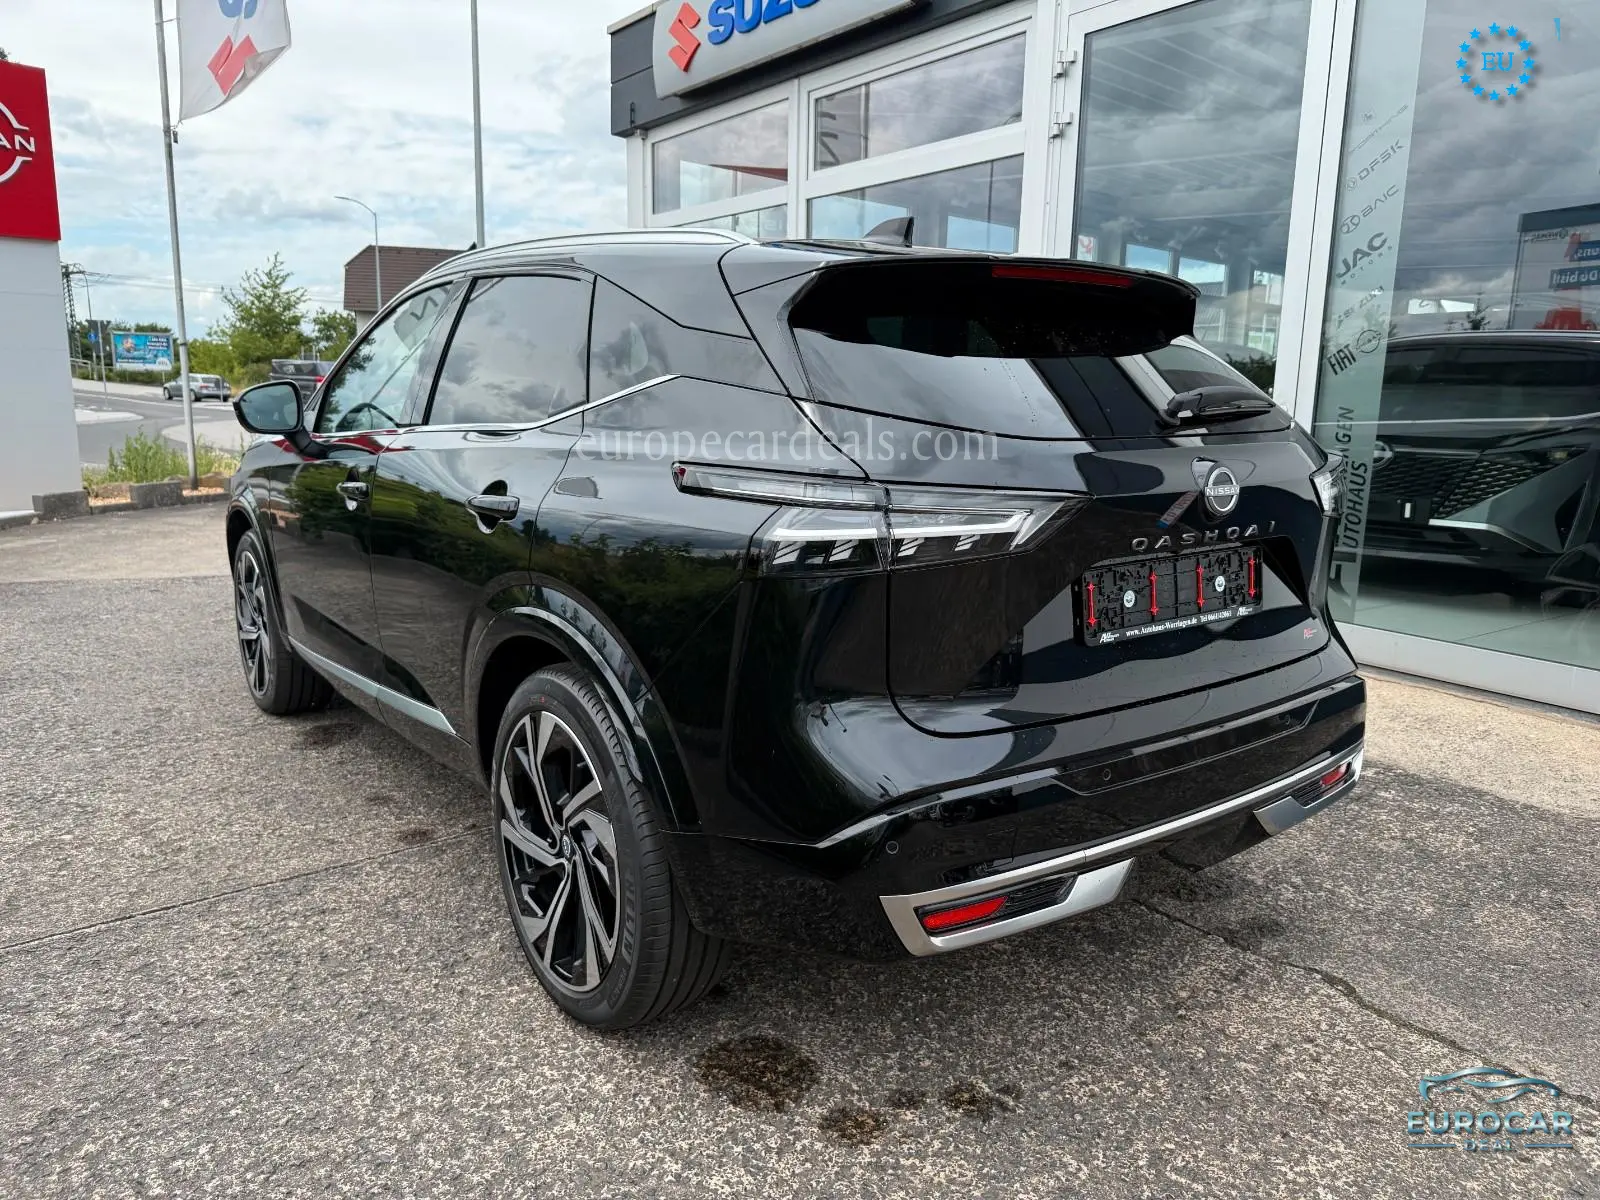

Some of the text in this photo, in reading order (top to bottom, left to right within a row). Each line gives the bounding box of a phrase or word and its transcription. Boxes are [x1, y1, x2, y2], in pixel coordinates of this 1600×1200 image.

[1358, 140, 1405, 181] DFSK
[1361, 184, 1400, 218] BAIC
[1336, 232, 1388, 278] JAC
[1327, 344, 1356, 376] FIAT
[1131, 520, 1276, 552] QASHQAI
